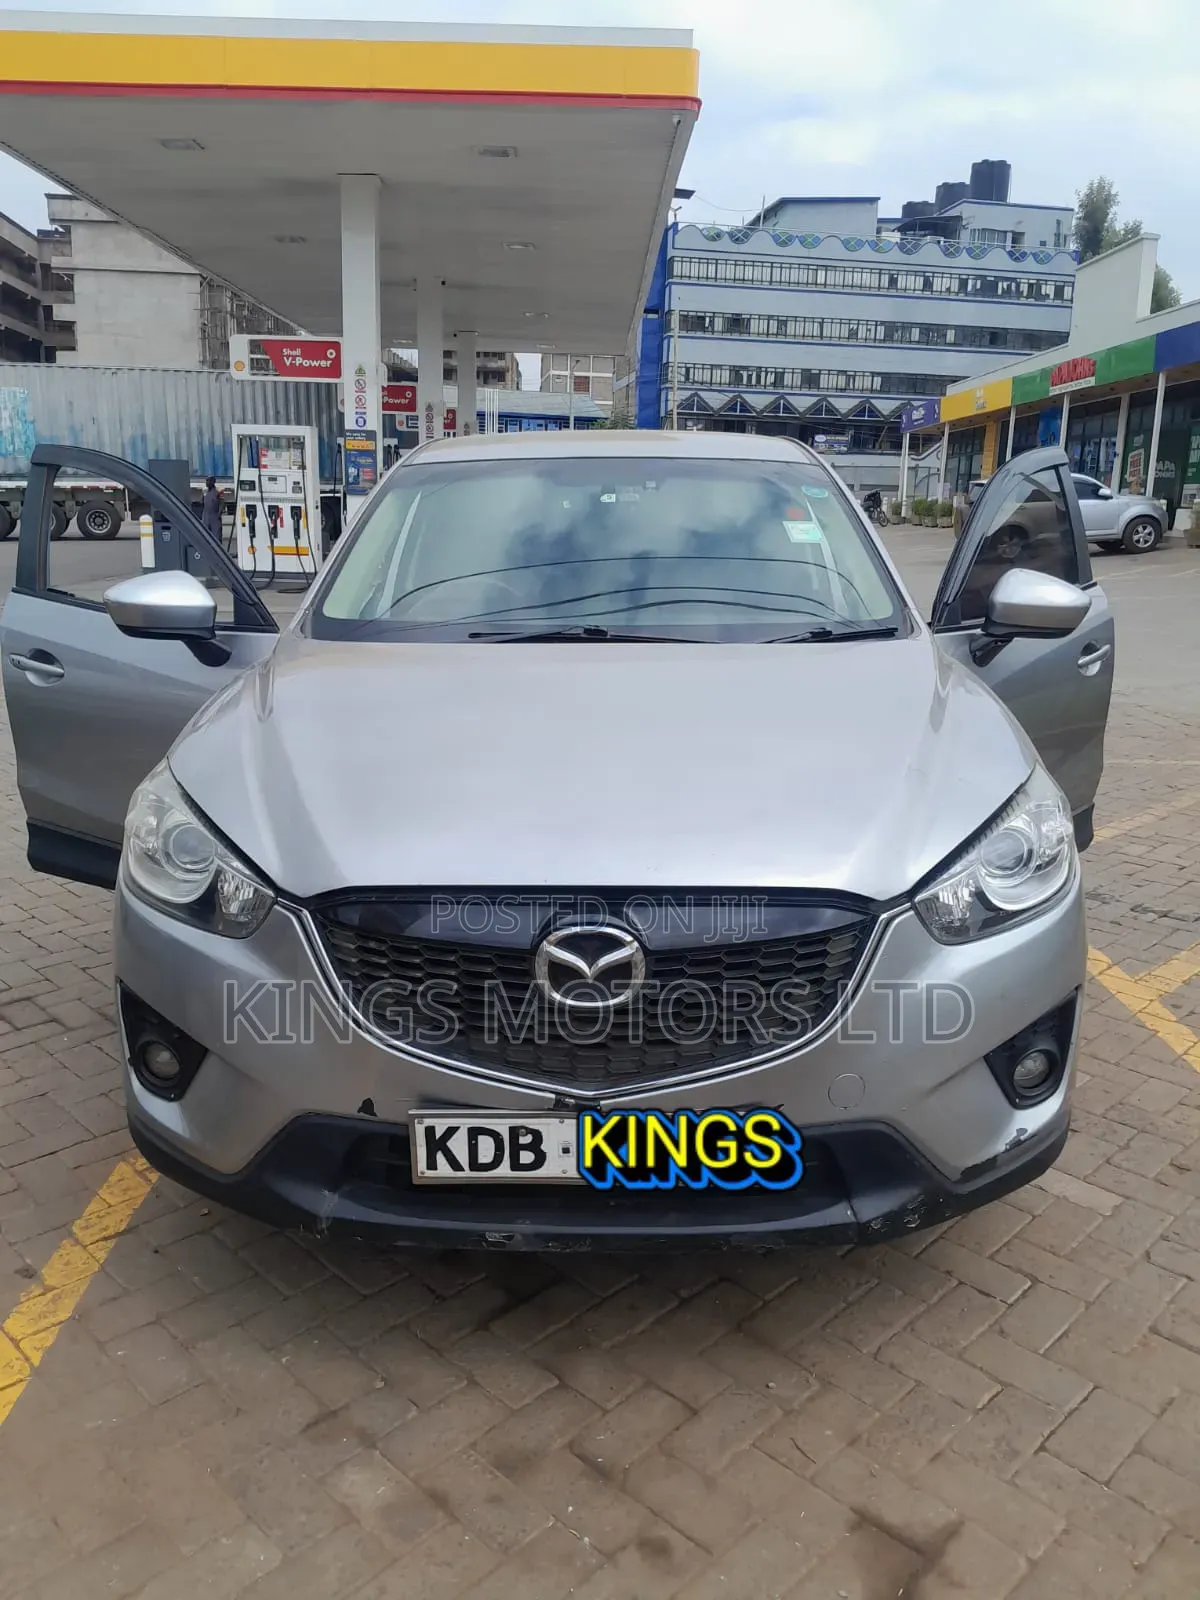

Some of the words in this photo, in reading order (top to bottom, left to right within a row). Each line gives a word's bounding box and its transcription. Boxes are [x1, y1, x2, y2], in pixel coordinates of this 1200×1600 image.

[282, 348, 301, 356] Shell
[283, 356, 332, 367] V-Power
[383, 396, 410, 405] Power
[424, 1125, 547, 1173] KDB
